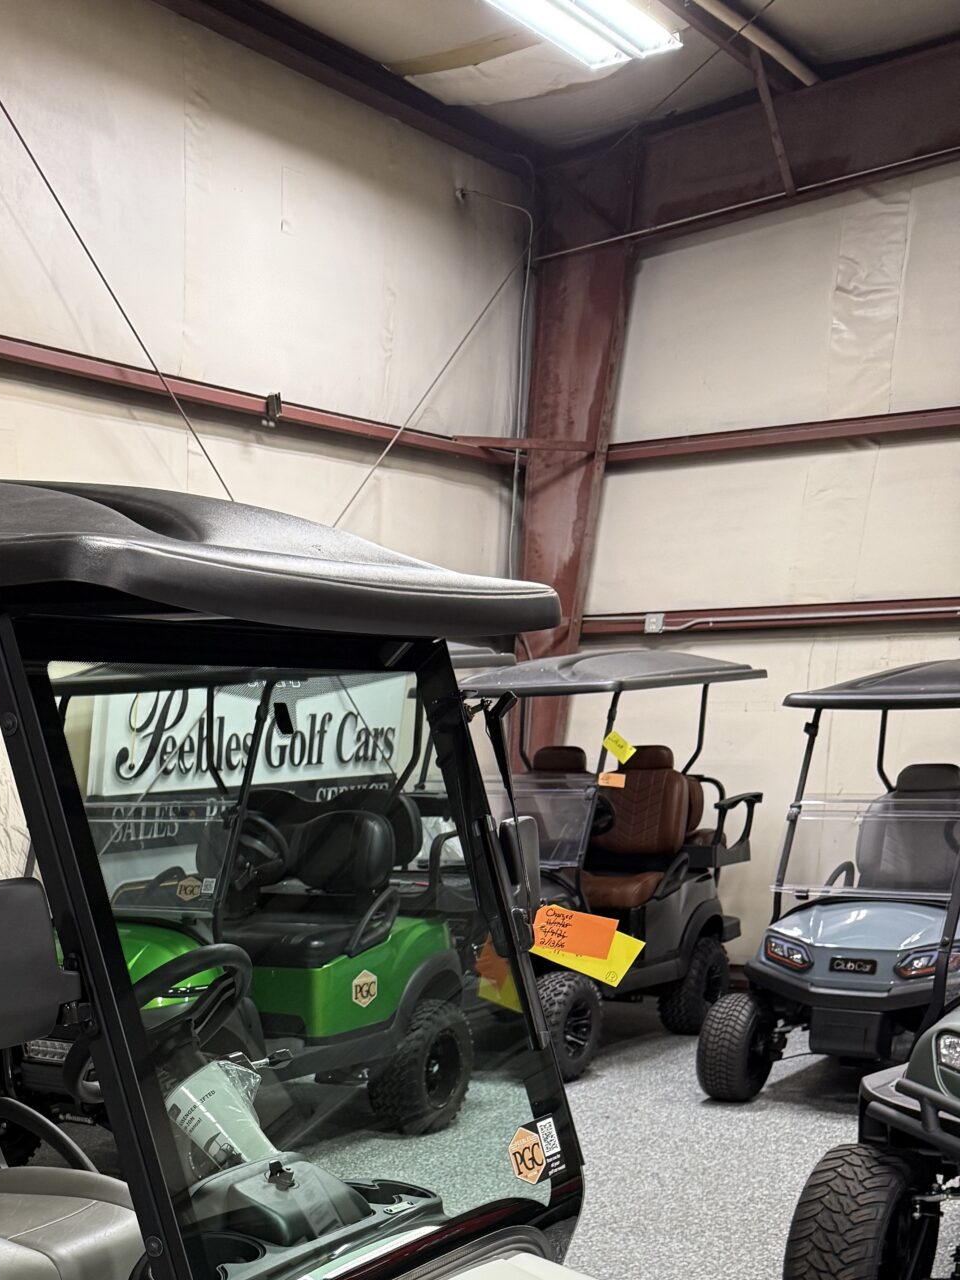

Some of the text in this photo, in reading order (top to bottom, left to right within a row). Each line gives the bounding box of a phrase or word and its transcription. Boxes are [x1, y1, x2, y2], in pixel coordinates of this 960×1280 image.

[264, 712, 333, 769] Golf
[336, 711, 396, 764] Cars
[355, 981, 376, 1000] PGC
[512, 1143, 544, 1176] PGC
